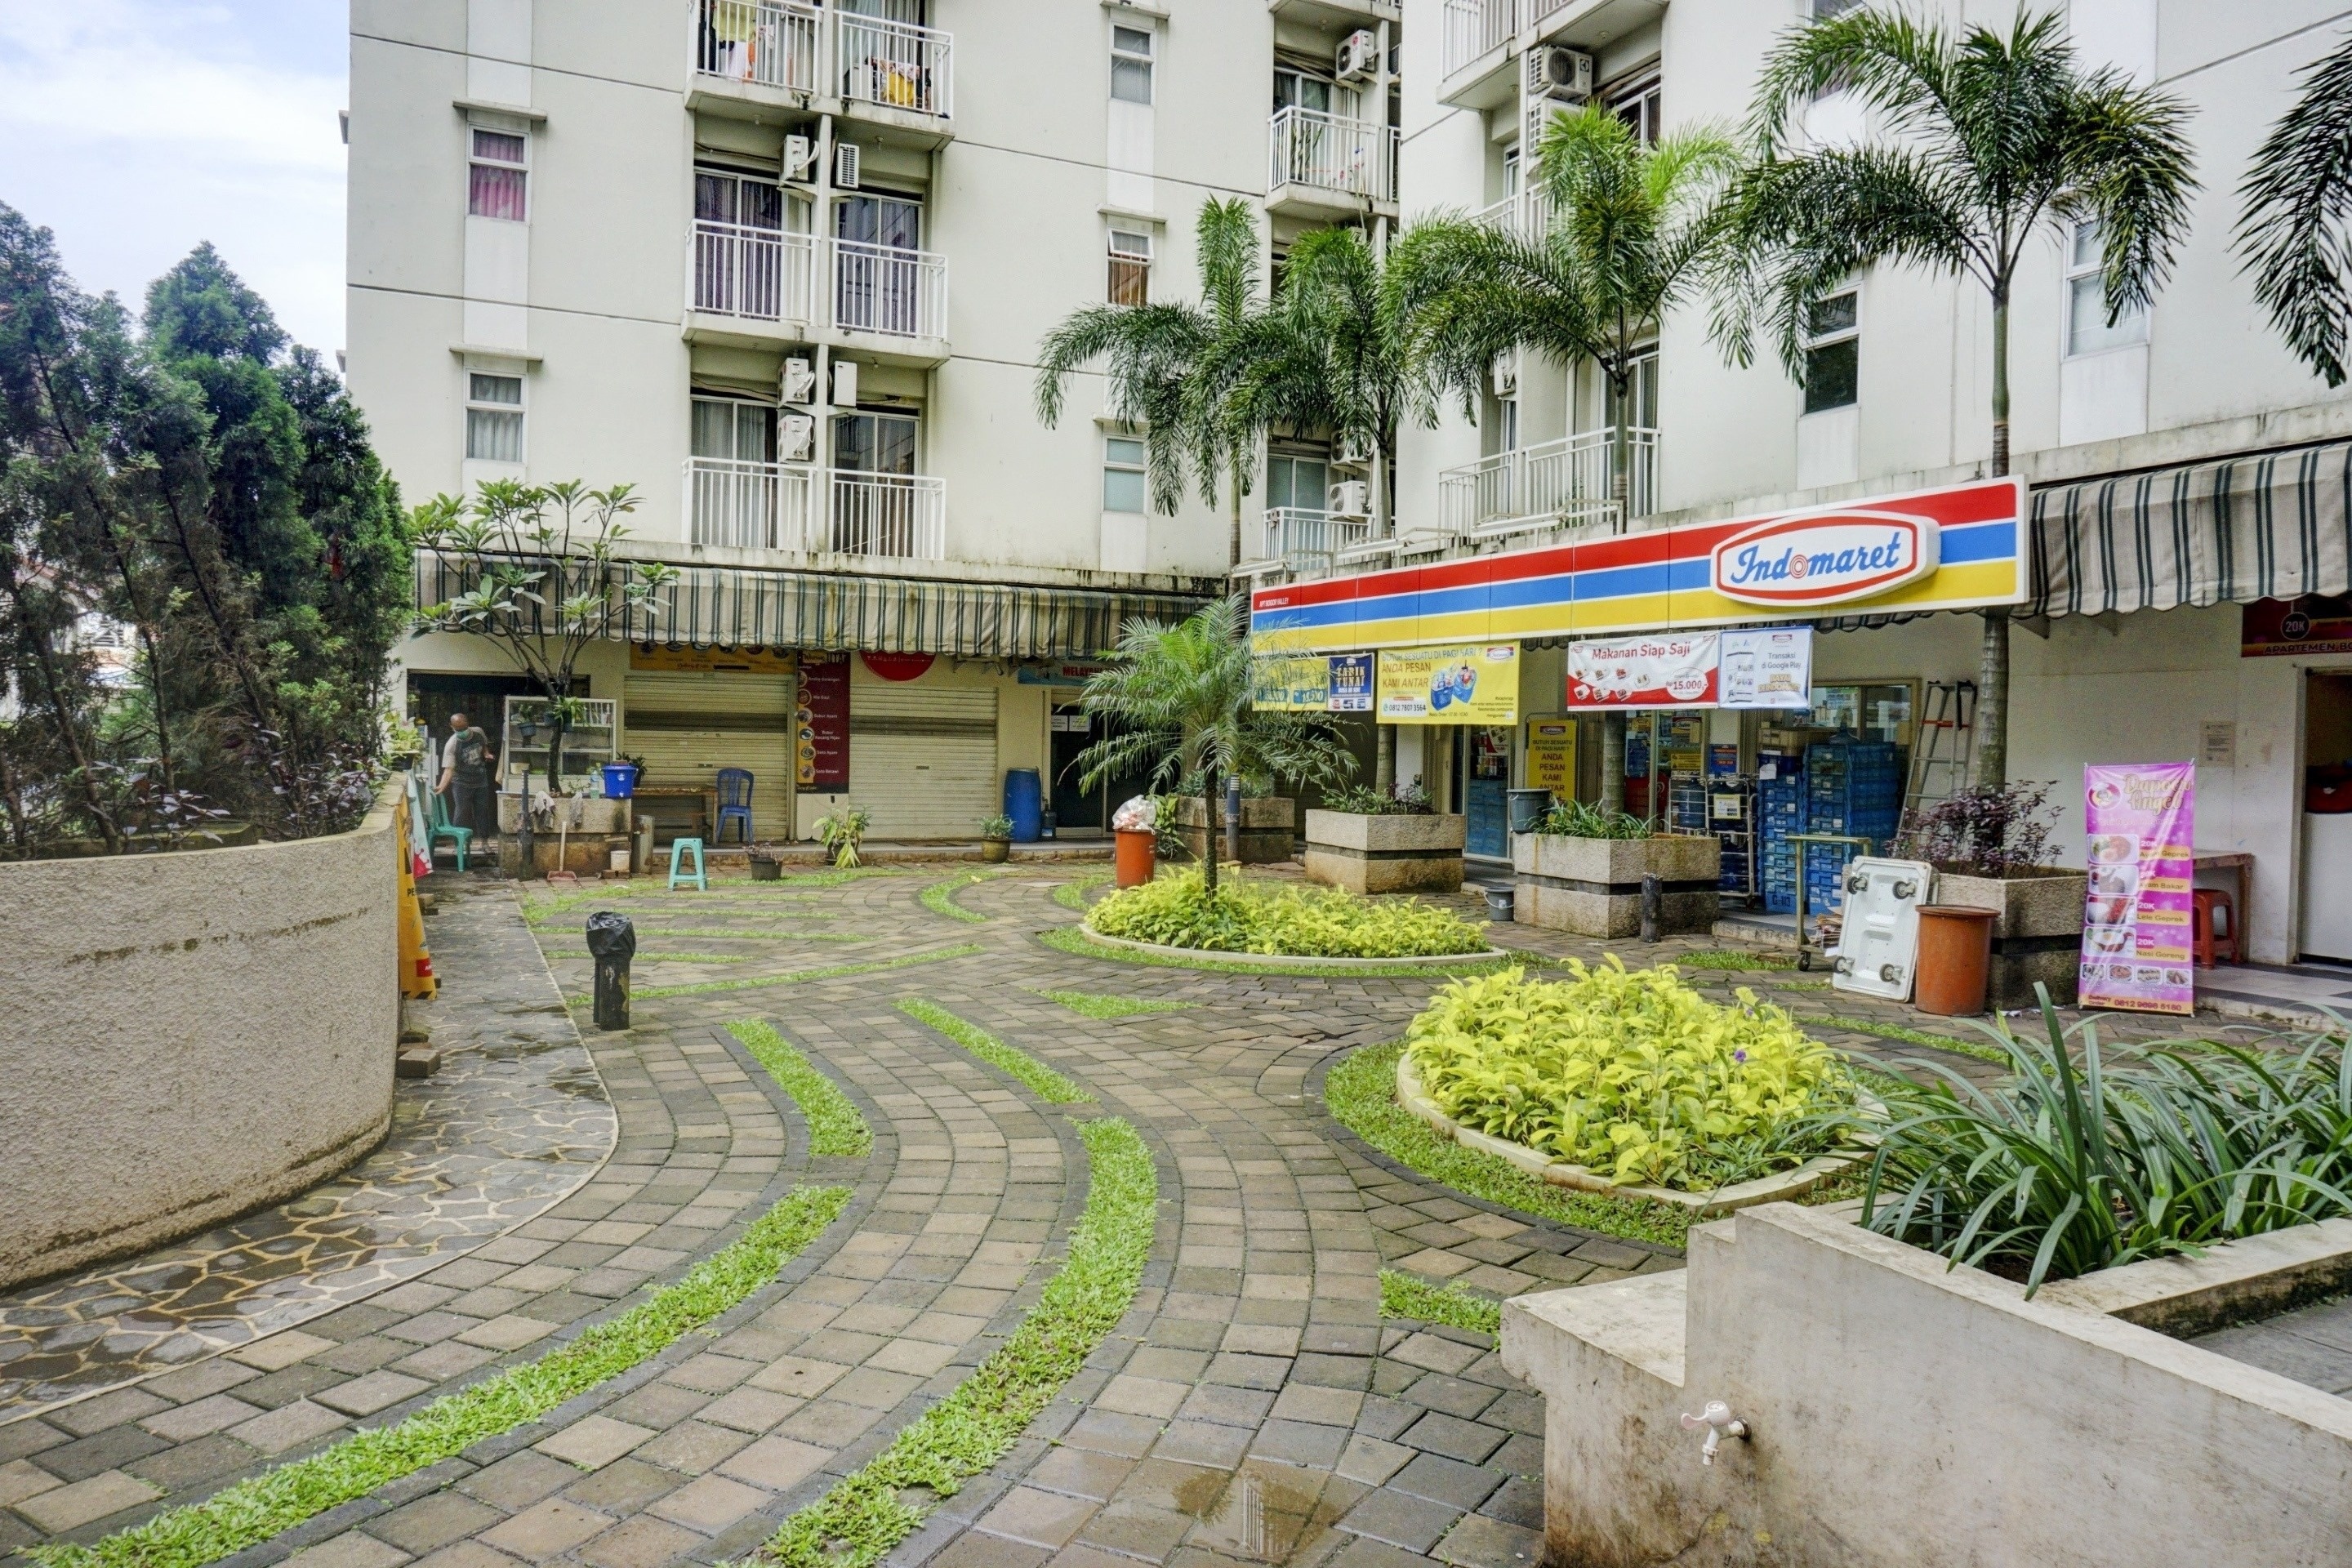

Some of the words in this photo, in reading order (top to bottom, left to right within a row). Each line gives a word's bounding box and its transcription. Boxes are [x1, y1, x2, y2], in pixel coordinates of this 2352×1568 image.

[1731, 532, 1901, 584] Indomaret
[2286, 621, 2305, 632] 20K
[1592, 648, 1637, 659] Makanan
[1640, 644, 1665, 658] Siap
[1669, 642, 1690, 657] Saji
[2265, 644, 2335, 654] APARTEMEN
[1404, 651, 1432, 661] SESUATU
[1382, 663, 1403, 673] ANDA
[1405, 662, 1431, 673] PESAN
[1767, 662, 1788, 670] Google
[1336, 676, 1365, 687] TUNAI
[1383, 679, 1400, 688] KAMI
[1401, 678, 1428, 688] ANTAR
[1539, 763, 1565, 771] PESAN
[2156, 951, 2185, 960] Goreng
